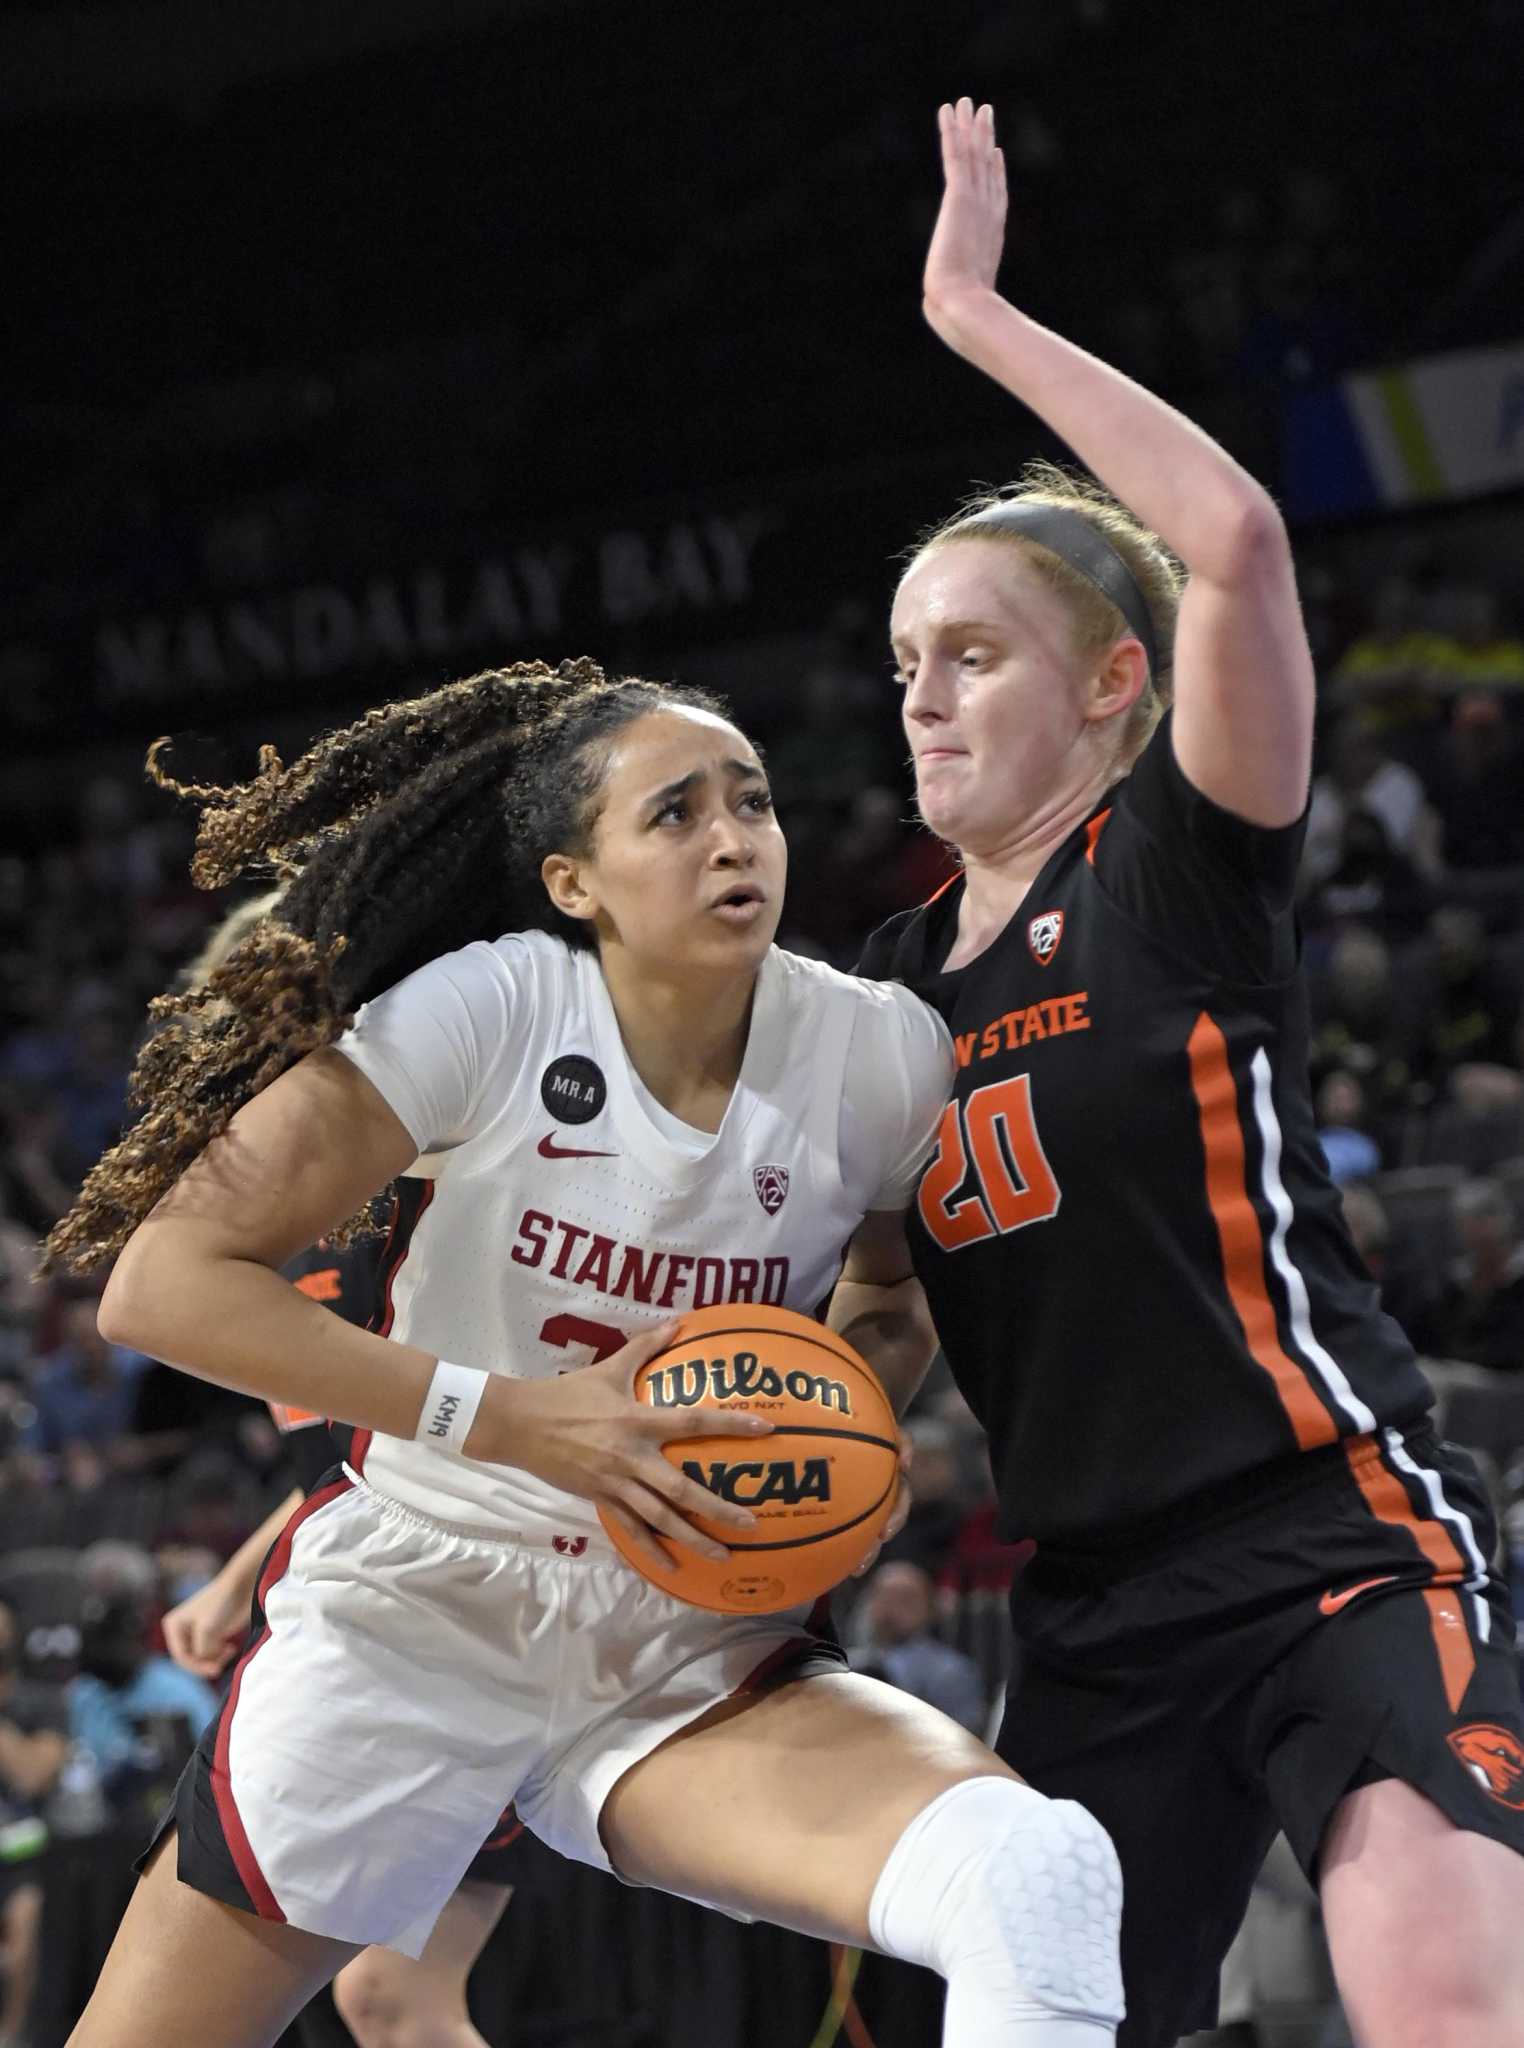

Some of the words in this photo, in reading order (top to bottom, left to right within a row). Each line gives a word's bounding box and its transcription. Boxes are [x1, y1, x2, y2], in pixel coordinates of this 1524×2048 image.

[101, 547, 572, 693] MANDALAY
[600, 514, 766, 623] BAY
[980, 991, 1090, 1059] STATE
[754, 1166, 789, 1196] PAC
[917, 1072, 1062, 1252] 20
[762, 1187, 780, 1206] 12
[511, 1209, 790, 1310] STANFORD
[647, 1352, 851, 1417] Wilson
[681, 1458, 830, 1506] NCAA
